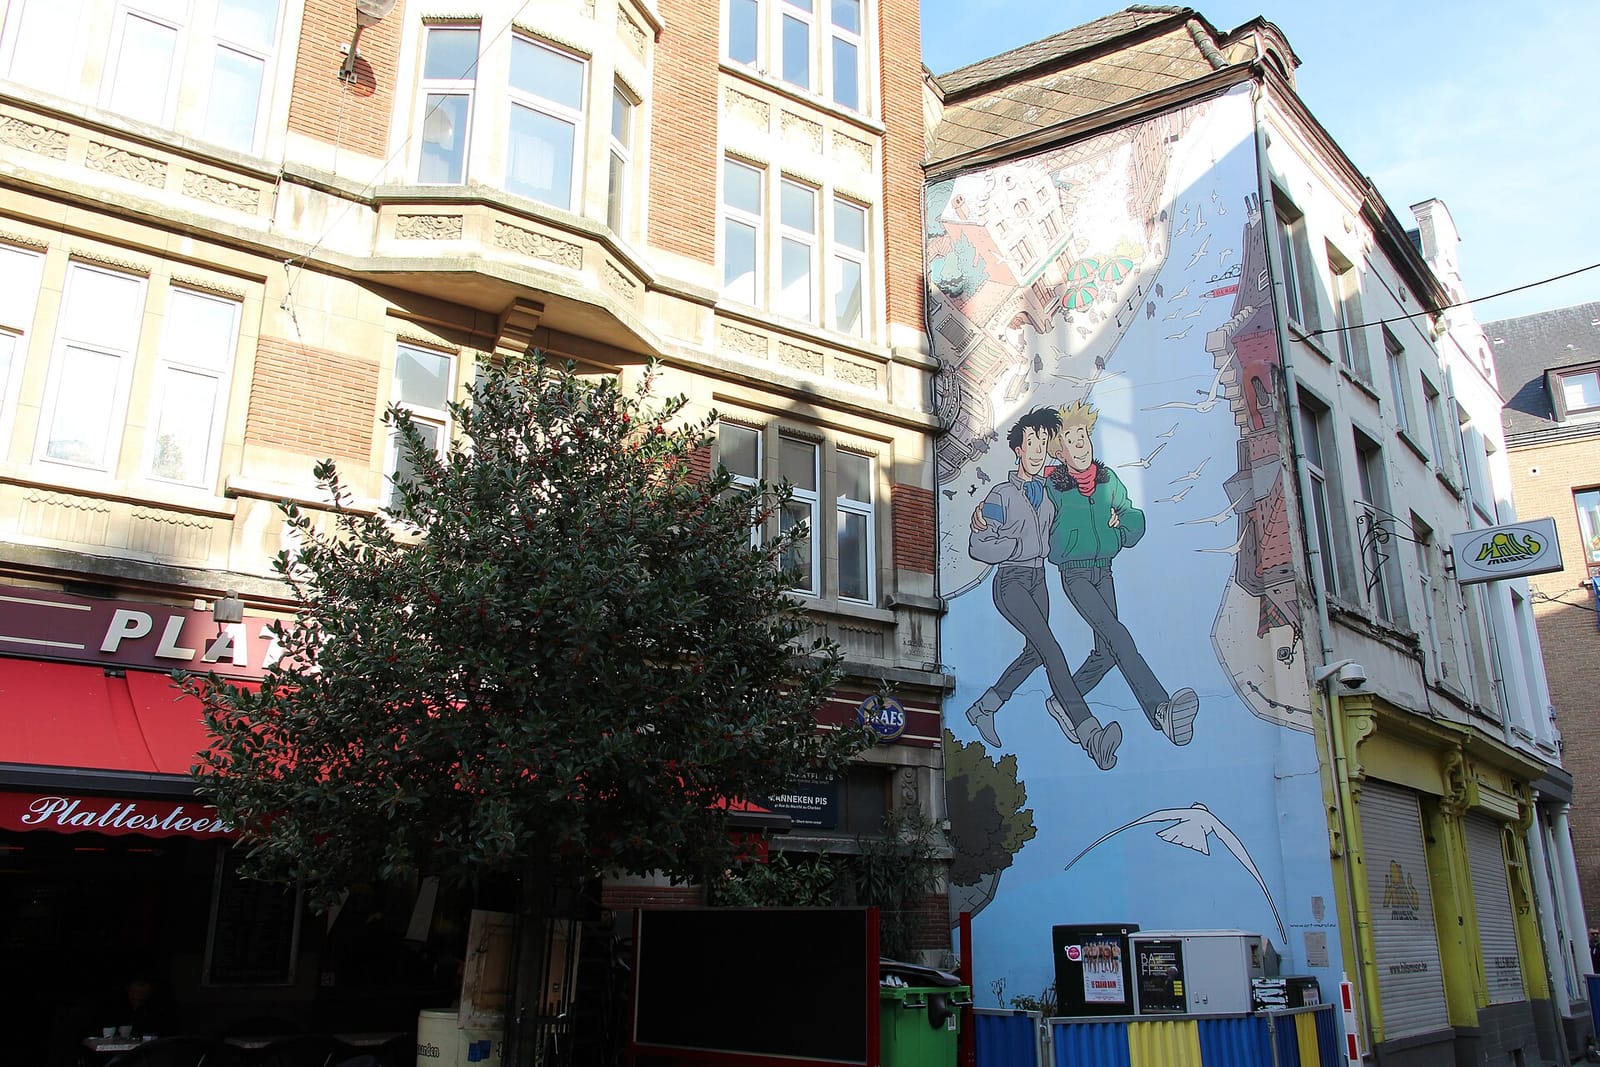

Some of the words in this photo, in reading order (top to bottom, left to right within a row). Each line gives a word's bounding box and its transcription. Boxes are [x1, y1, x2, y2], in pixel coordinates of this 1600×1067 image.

[815, 797, 828, 806] PIS
[21, 796, 235, 834] Plattesteen
[1518, 905, 1530, 915] 37
